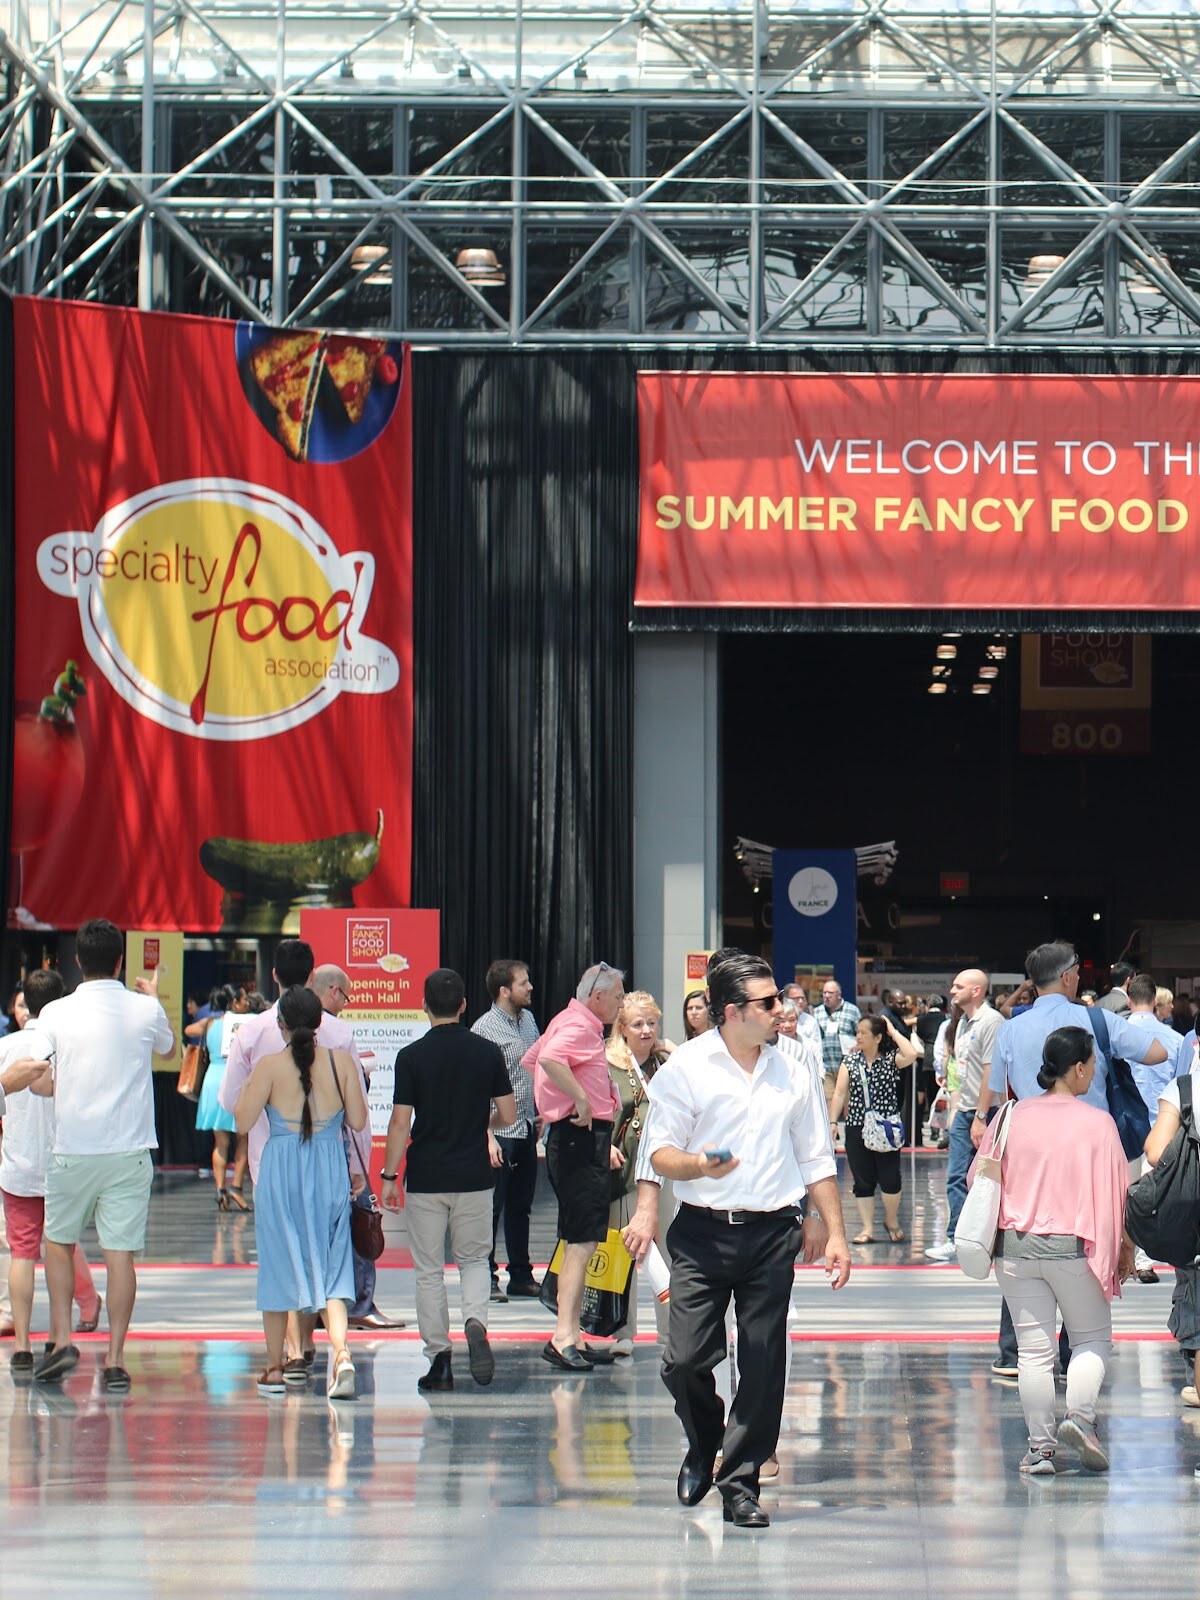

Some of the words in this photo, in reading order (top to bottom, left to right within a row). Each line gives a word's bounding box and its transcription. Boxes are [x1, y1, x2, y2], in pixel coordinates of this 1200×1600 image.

[795, 439, 1037, 475] WELCOME
[1055, 440, 1116, 476] TO
[655, 495, 857, 531] SUMMER
[875, 497, 1034, 532] FANCY
[1051, 498, 1188, 533] FOOD
[50, 541, 219, 594] specialty
[190, 521, 363, 725] food
[1051, 633, 1123, 648] FOOD
[1052, 723, 1123, 749] 800
[352, 930, 384, 939] FANCY
[352, 938, 384, 948] FOOD
[352, 948, 384, 957] SHOW
[399, 978, 410, 989] in
[378, 992, 401, 1003] Hall
[372, 1029, 413, 1037] LOUNGE
